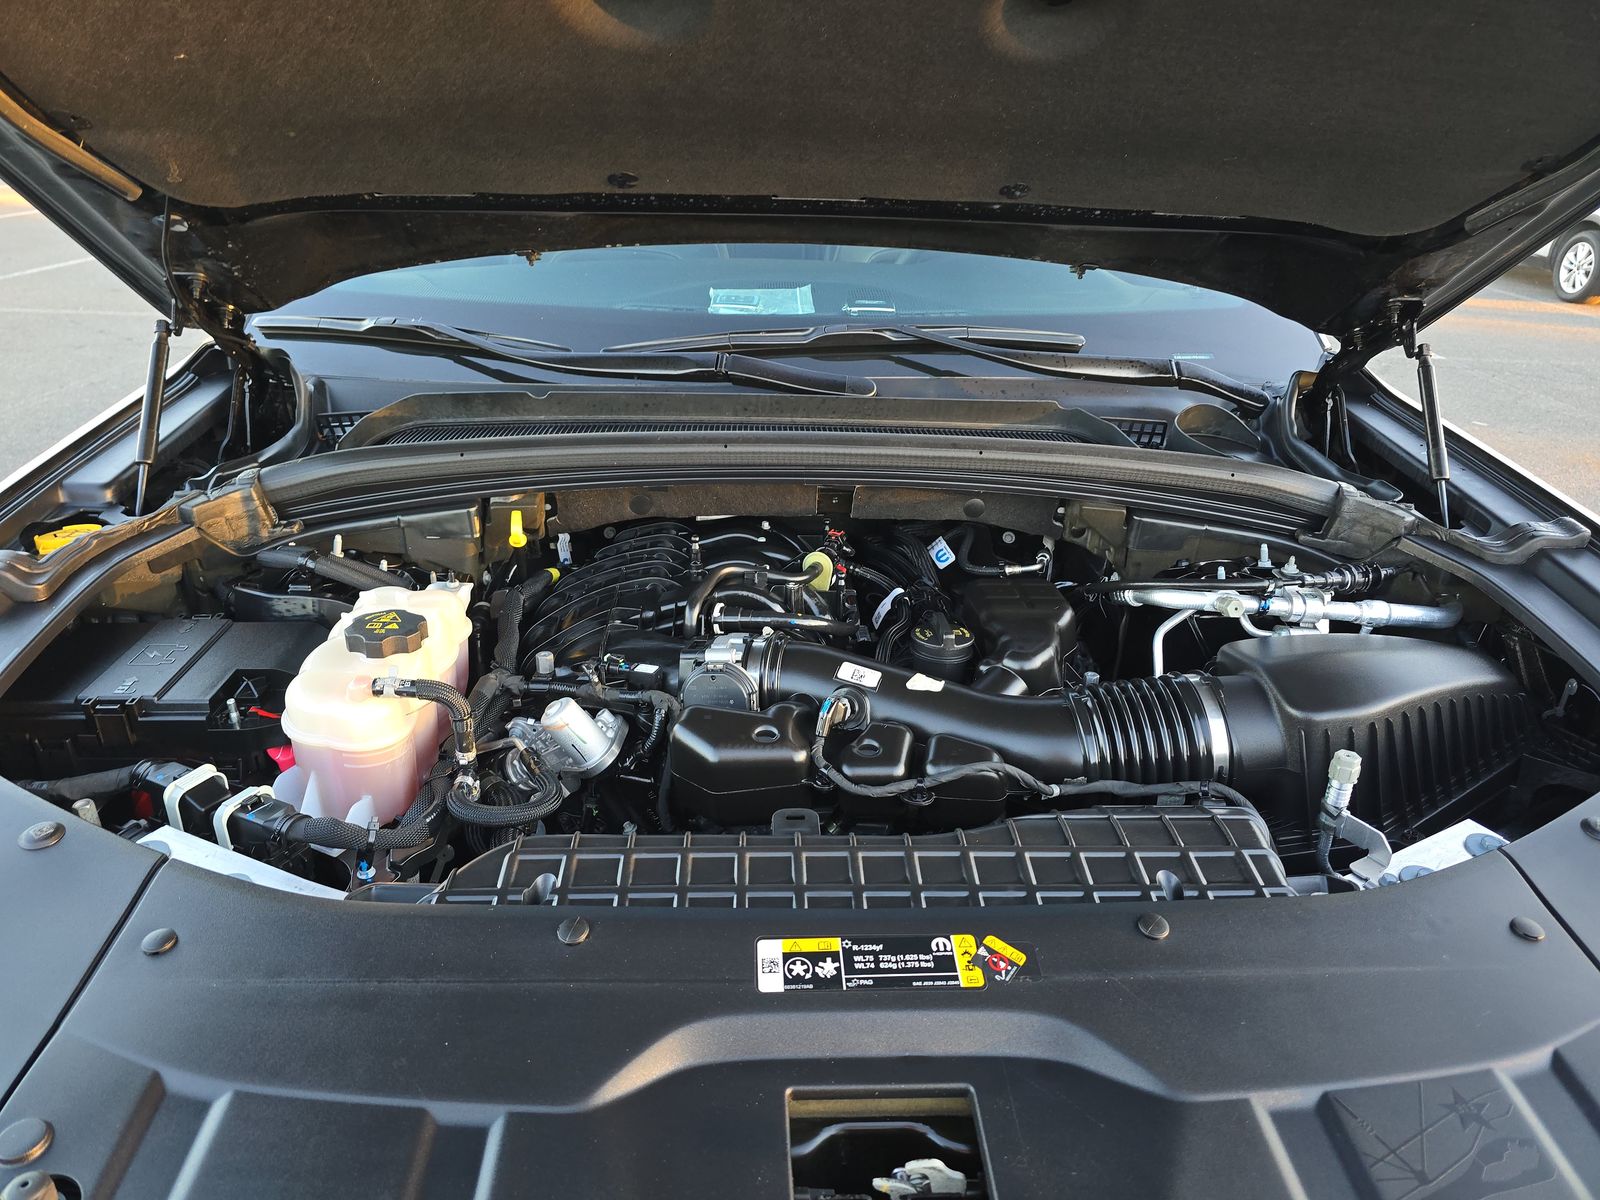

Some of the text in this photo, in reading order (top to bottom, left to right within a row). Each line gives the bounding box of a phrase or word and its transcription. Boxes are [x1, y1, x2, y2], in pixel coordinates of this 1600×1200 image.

[852, 944, 883, 952] R-1234yf
[878, 954, 896, 963] 737g
[919, 953, 933, 961] lbs)
[898, 961, 919, 969] (1.375
